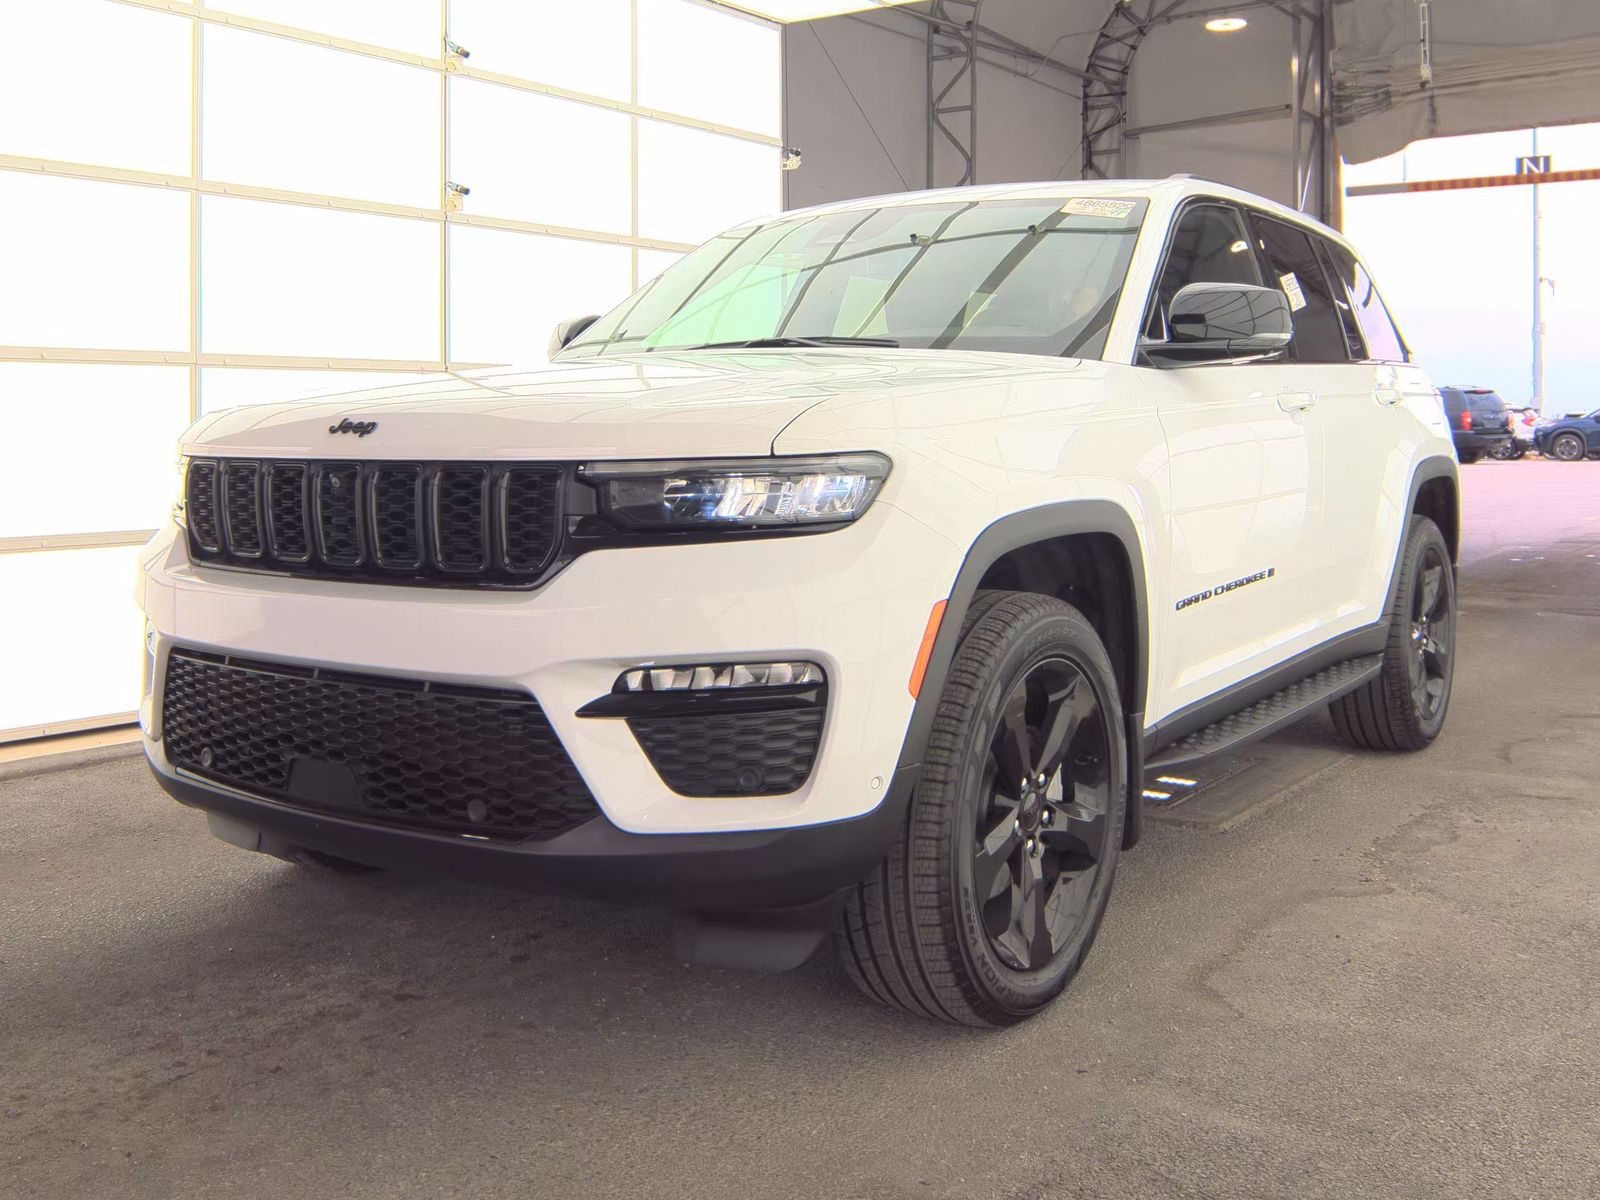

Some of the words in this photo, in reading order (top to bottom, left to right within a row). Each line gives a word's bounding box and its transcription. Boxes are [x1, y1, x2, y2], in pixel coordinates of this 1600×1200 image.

[1522, 156, 1545, 175] N
[328, 418, 379, 438] Jeep
[1175, 590, 1212, 611] GRAND
[1213, 570, 1266, 596] CHEROKEE
